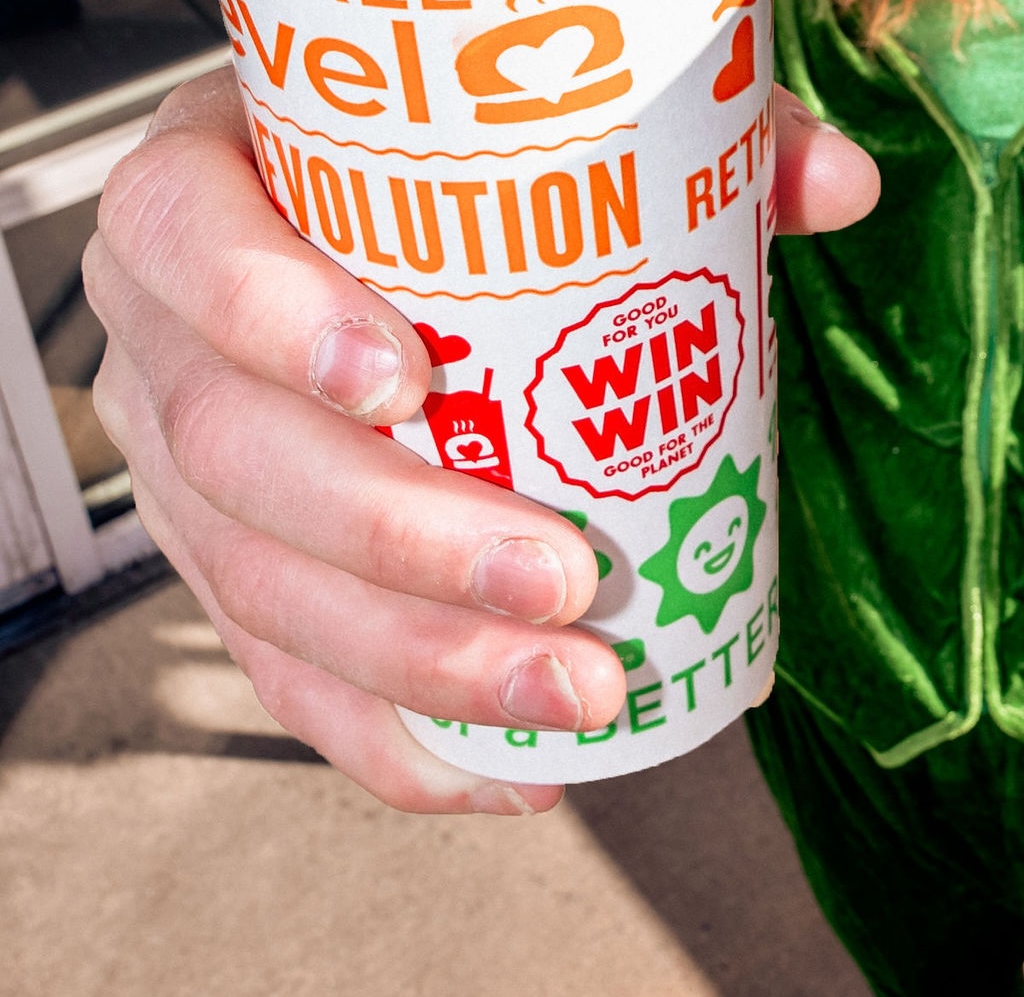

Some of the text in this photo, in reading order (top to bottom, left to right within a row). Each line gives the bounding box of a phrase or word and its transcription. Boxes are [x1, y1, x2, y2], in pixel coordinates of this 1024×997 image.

[249, 113, 643, 275] EVOLUTION
[602, 304, 678, 347] FOR YOU
[613, 296, 667, 326] GOOD
[560, 300, 719, 410] WIN
[571, 351, 723, 462] WIN
[603, 413, 715, 477] GOOD FOR THE
[641, 442, 694, 478] PLANET
